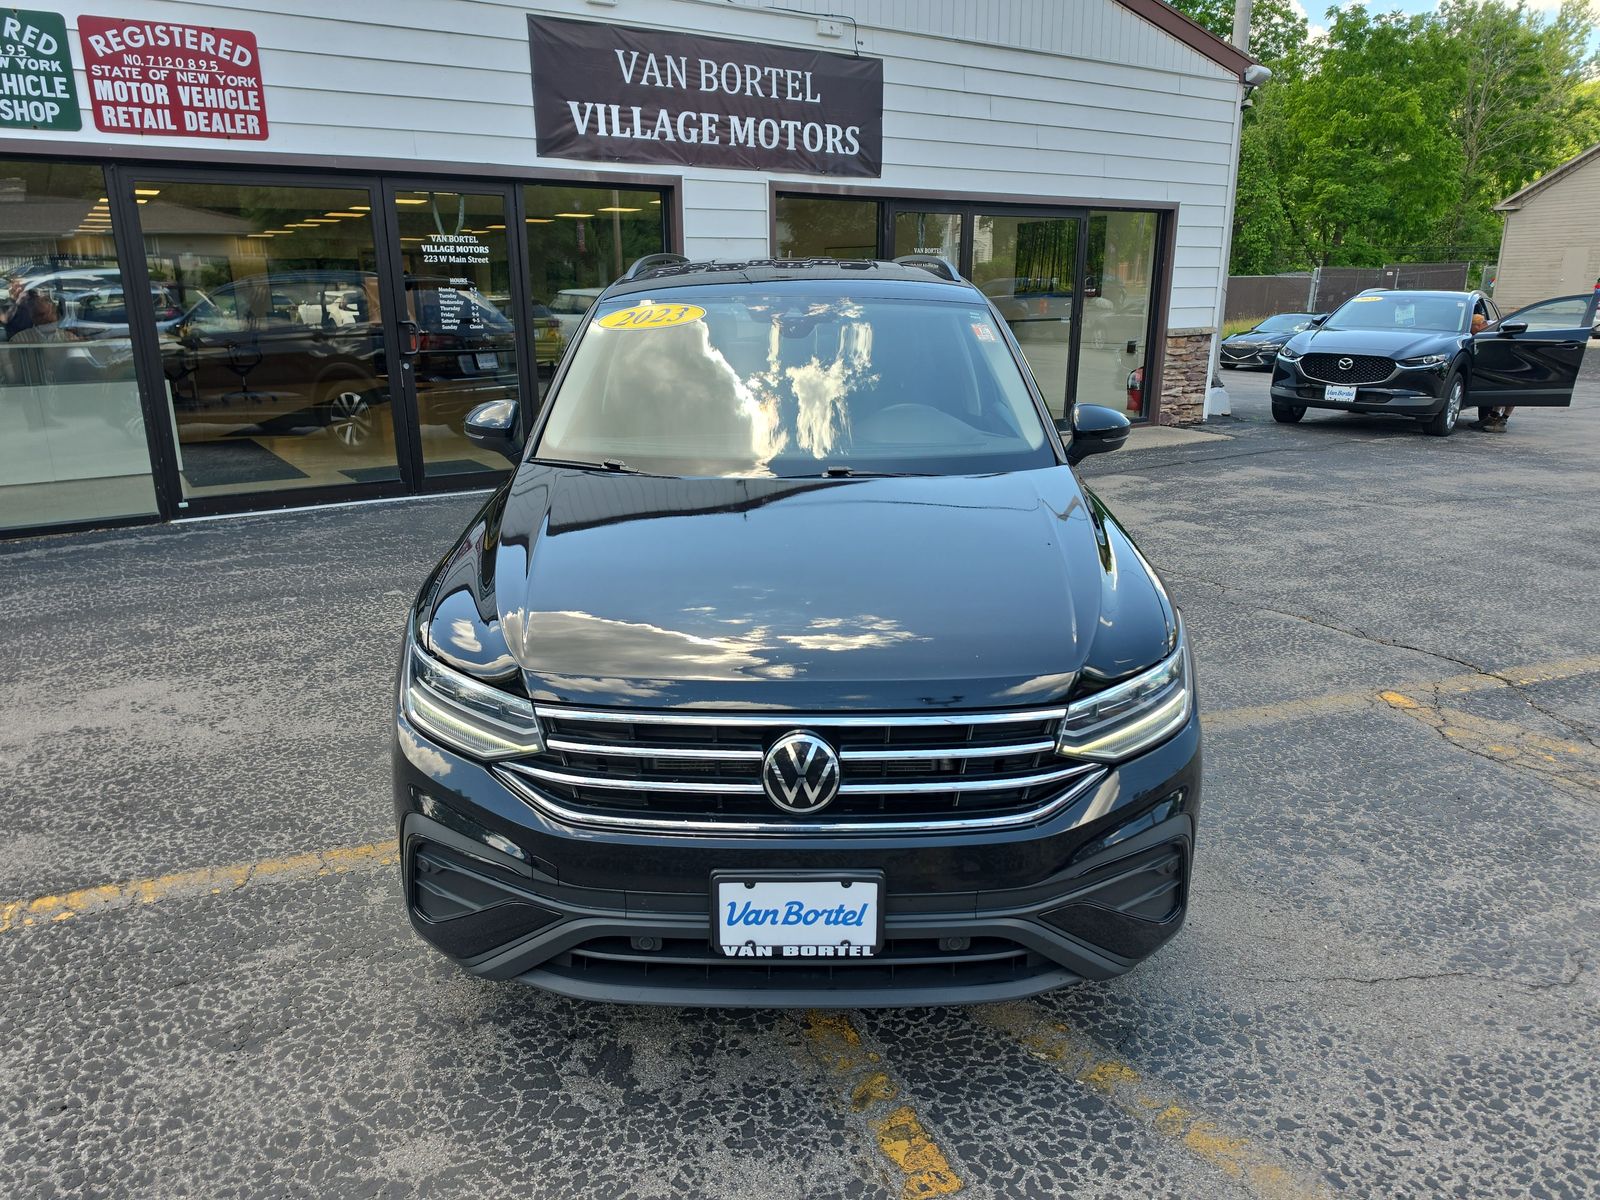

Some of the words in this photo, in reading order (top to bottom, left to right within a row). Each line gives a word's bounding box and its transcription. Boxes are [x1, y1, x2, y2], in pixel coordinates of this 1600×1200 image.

[0, 43, 27, 56] 95
[88, 24, 252, 67] REGISTERED
[15, 57, 63, 72] YORK
[123, 53, 144, 66] NO.
[146, 55, 219, 72] 7120895
[0, 73, 70, 98] HICLE
[91, 65, 142, 79] STATE
[148, 69, 169, 81] OF
[176, 71, 209, 84] NEW
[215, 74, 258, 88] YORK
[614, 48, 687, 90] VAN
[699, 58, 821, 103] BORTEL
[93, 79, 170, 105] MOTOR
[177, 85, 261, 111] VEHICLE
[0, 98, 60, 123] SHOP
[101, 105, 177, 130] RETAIL
[184, 110, 261, 135] DEALER
[567, 100, 720, 145] VILLAGE
[728, 115, 860, 156] MOTORS
[421, 244, 455, 253] VILLAGE
[456, 245, 490, 254] MOTORS
[430, 235, 447, 243] VAN
[449, 235, 479, 243] BORTEL
[423, 254, 438, 263] 223
[439, 255, 447, 263] W
[448, 255, 467, 263] Main
[467, 255, 489, 264] Street
[613, 307, 689, 327] 2023
[727, 901, 779, 926] Van
[781, 901, 869, 927] Bortel
[722, 945, 773, 957] VAN
[782, 945, 874, 957] BORTEL
